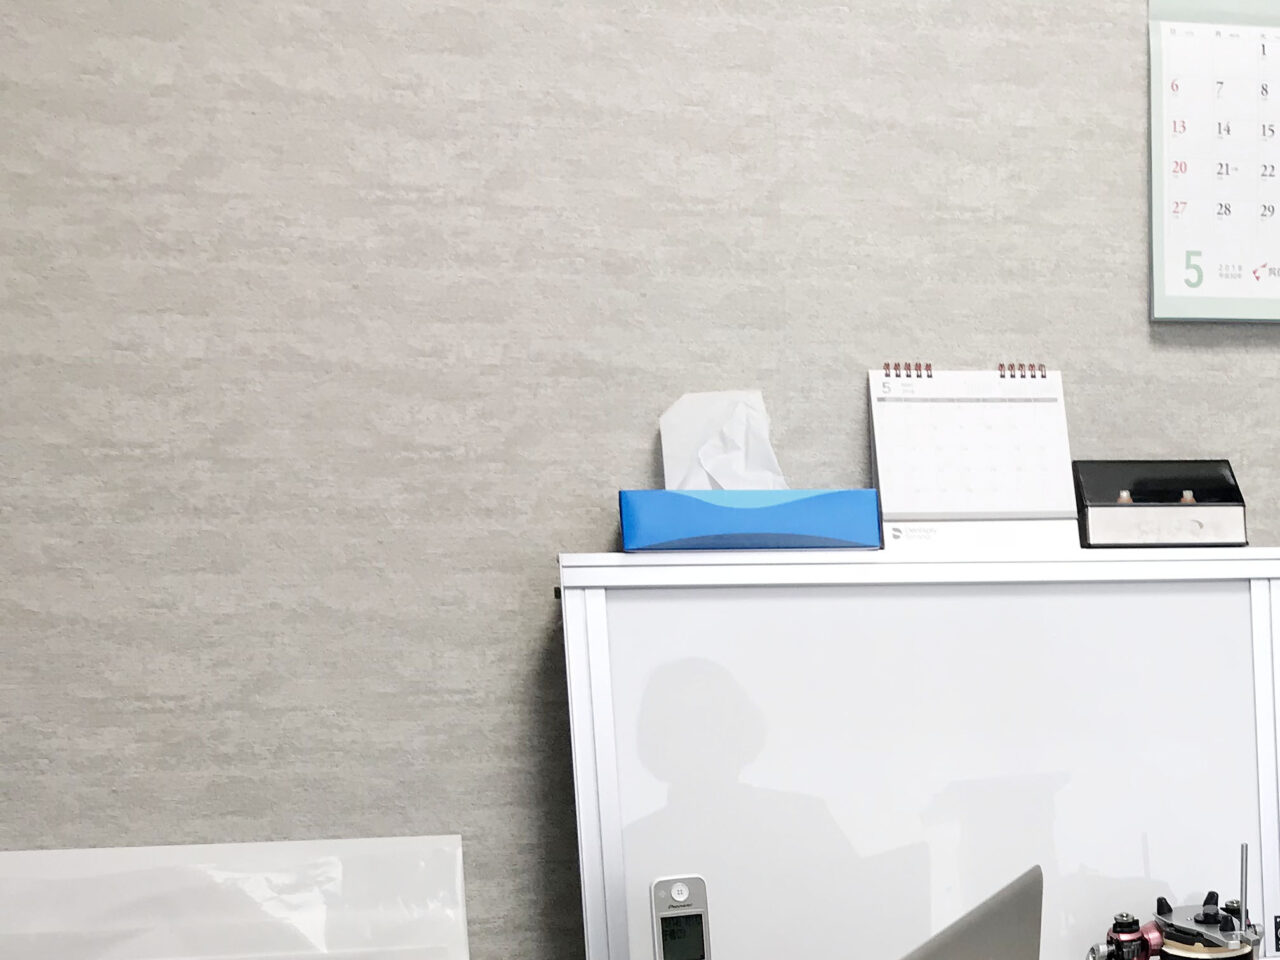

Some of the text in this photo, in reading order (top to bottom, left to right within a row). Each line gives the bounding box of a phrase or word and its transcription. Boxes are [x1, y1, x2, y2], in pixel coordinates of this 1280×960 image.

[1261, 43, 1267, 56] 1
[1171, 79, 1179, 92] 6
[1216, 81, 1224, 95] 7
[1261, 83, 1269, 96] 8
[1173, 120, 1187, 133] 13
[1217, 122, 1231, 135] 14
[1261, 124, 1275, 137] 15
[1172, 161, 1187, 174] 20
[1217, 162, 1231, 176] 21
[1261, 164, 1276, 177] 22
[1172, 201, 1187, 214] 27
[1217, 203, 1232, 216] 28
[1260, 205, 1275, 217] 29
[1184, 250, 1204, 288] 5
[882, 382, 891, 394] 5
